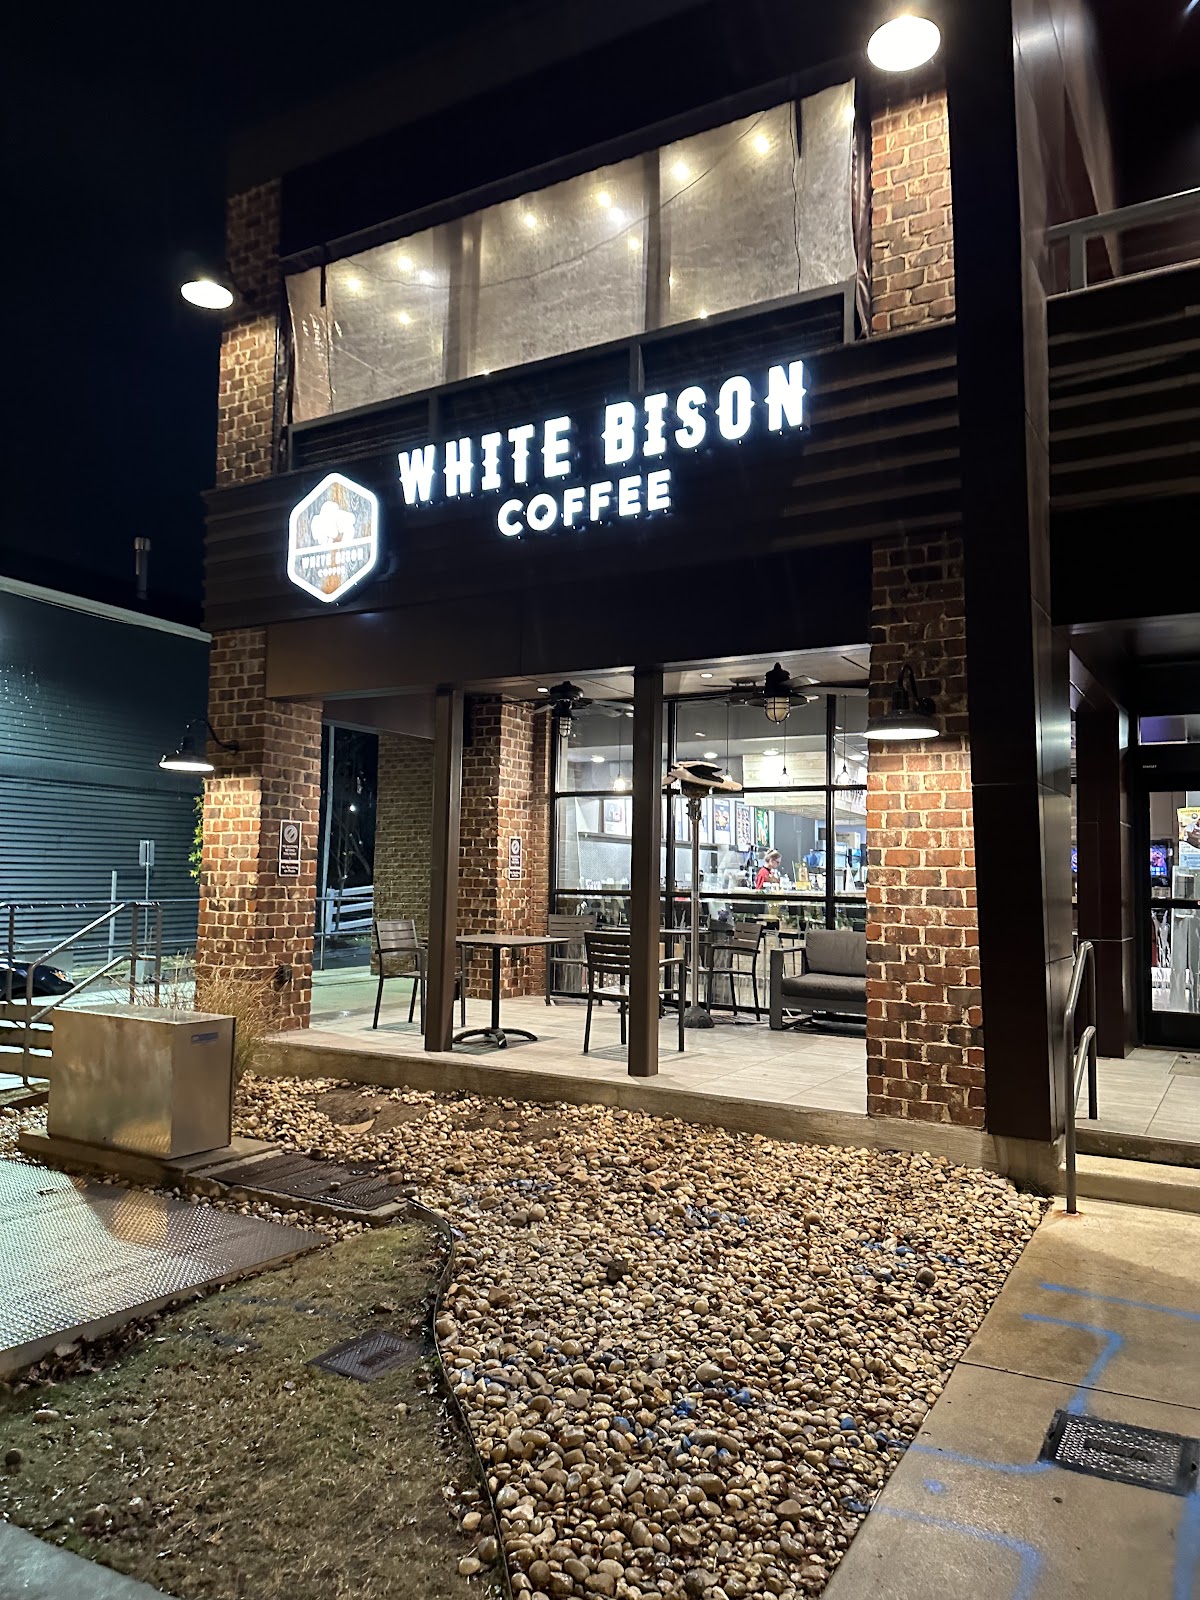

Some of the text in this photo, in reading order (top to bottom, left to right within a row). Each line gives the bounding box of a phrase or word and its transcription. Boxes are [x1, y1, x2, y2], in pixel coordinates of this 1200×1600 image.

[398, 360, 808, 505] WHITE BISON
[497, 469, 671, 537] COFFEE
